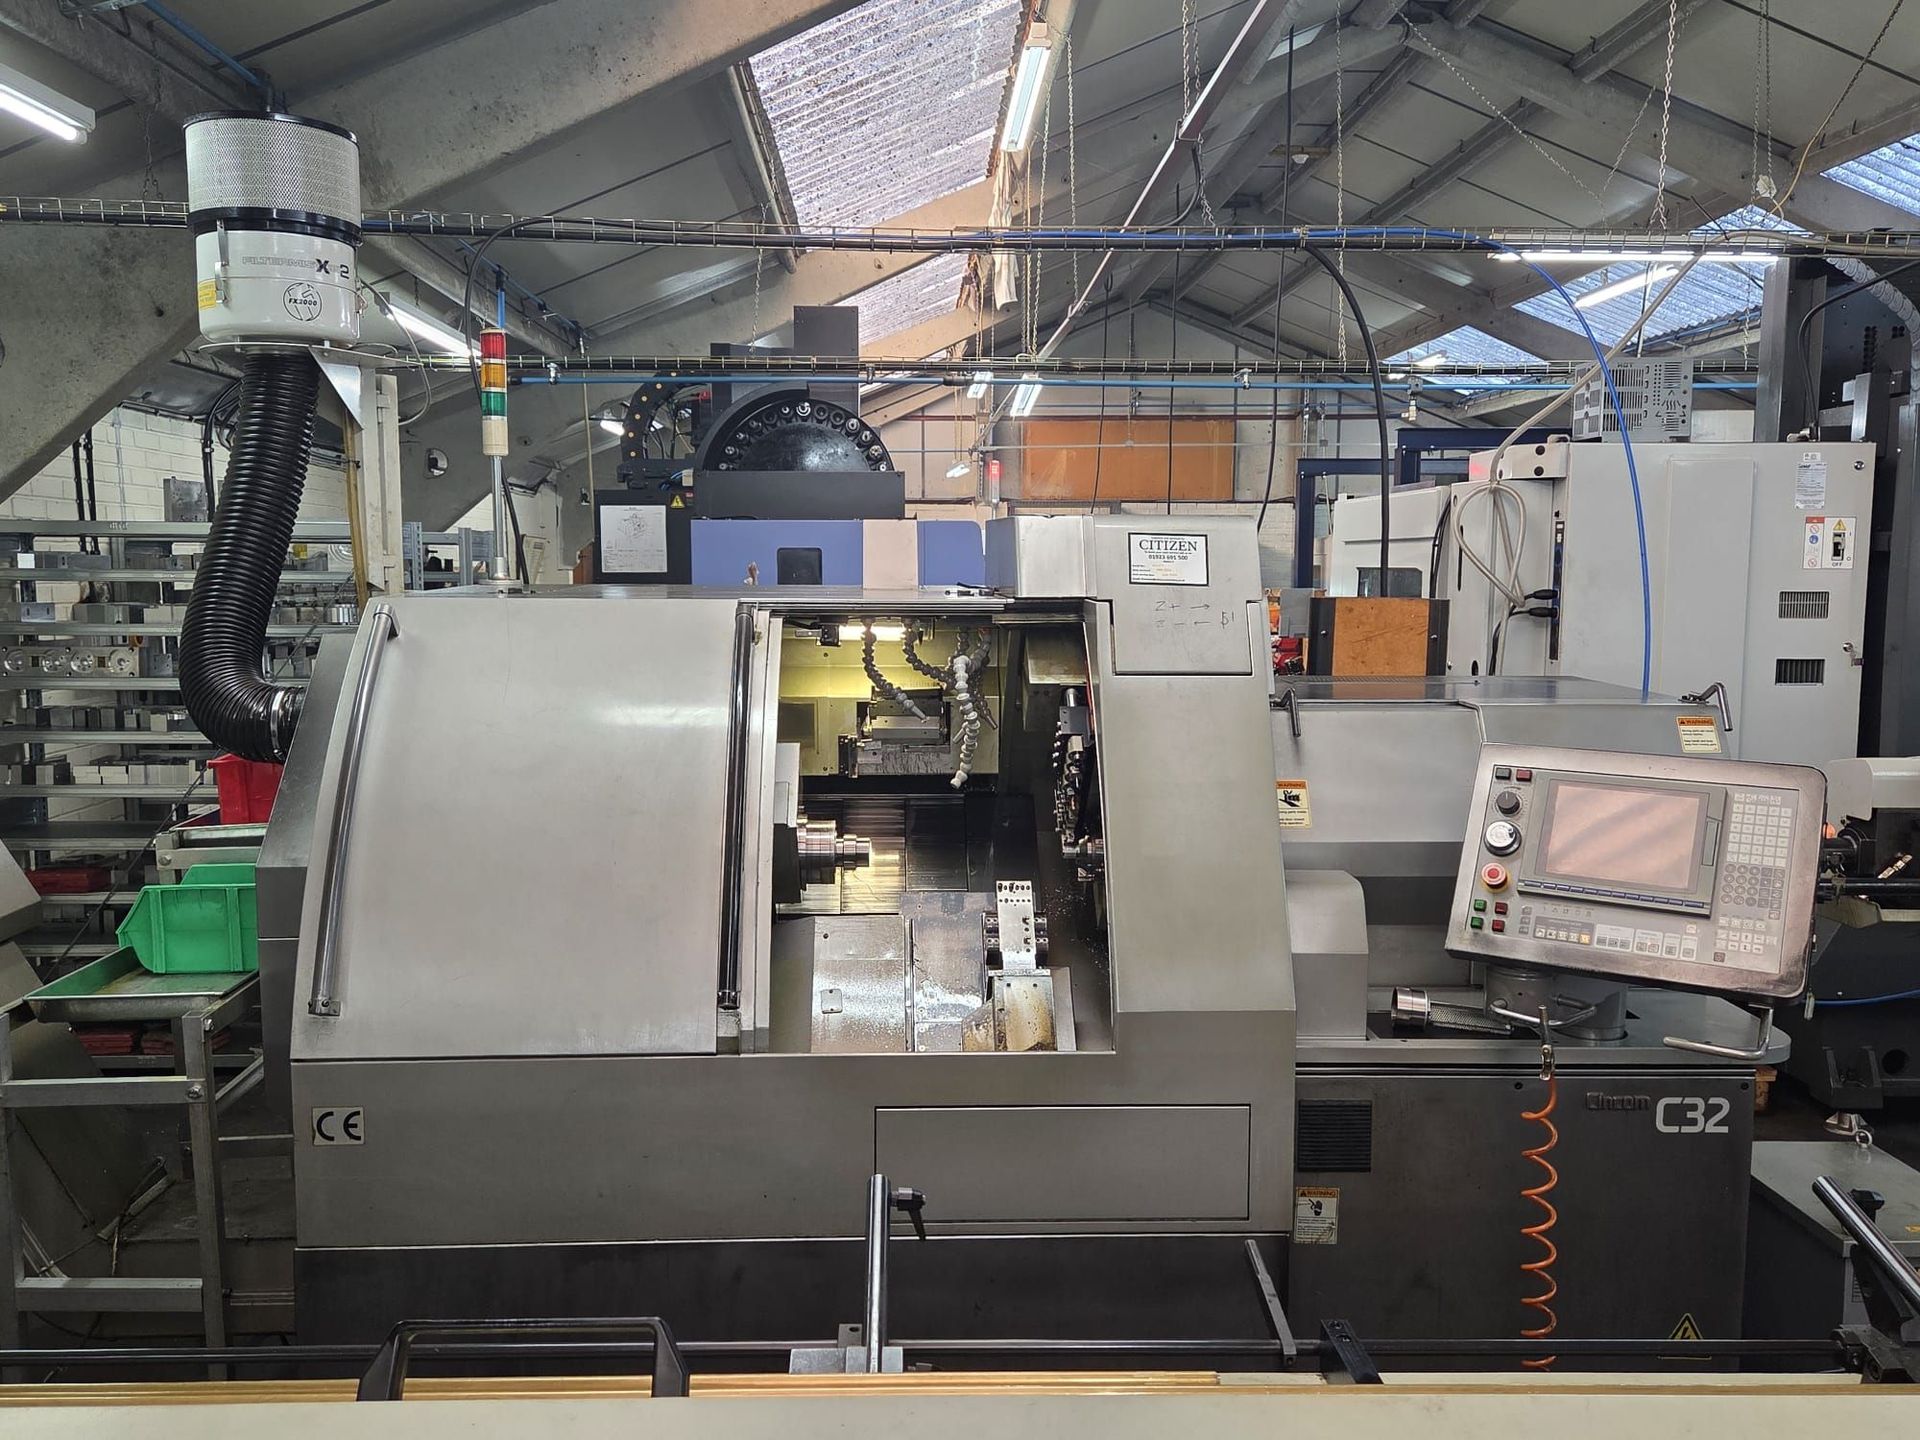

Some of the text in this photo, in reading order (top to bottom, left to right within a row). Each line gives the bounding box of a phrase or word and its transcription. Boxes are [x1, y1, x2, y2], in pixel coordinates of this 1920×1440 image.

[1139, 539, 1197, 551] CITIZEN
[316, 1110, 362, 1142] CE
[1655, 1097, 1730, 1133] C32
